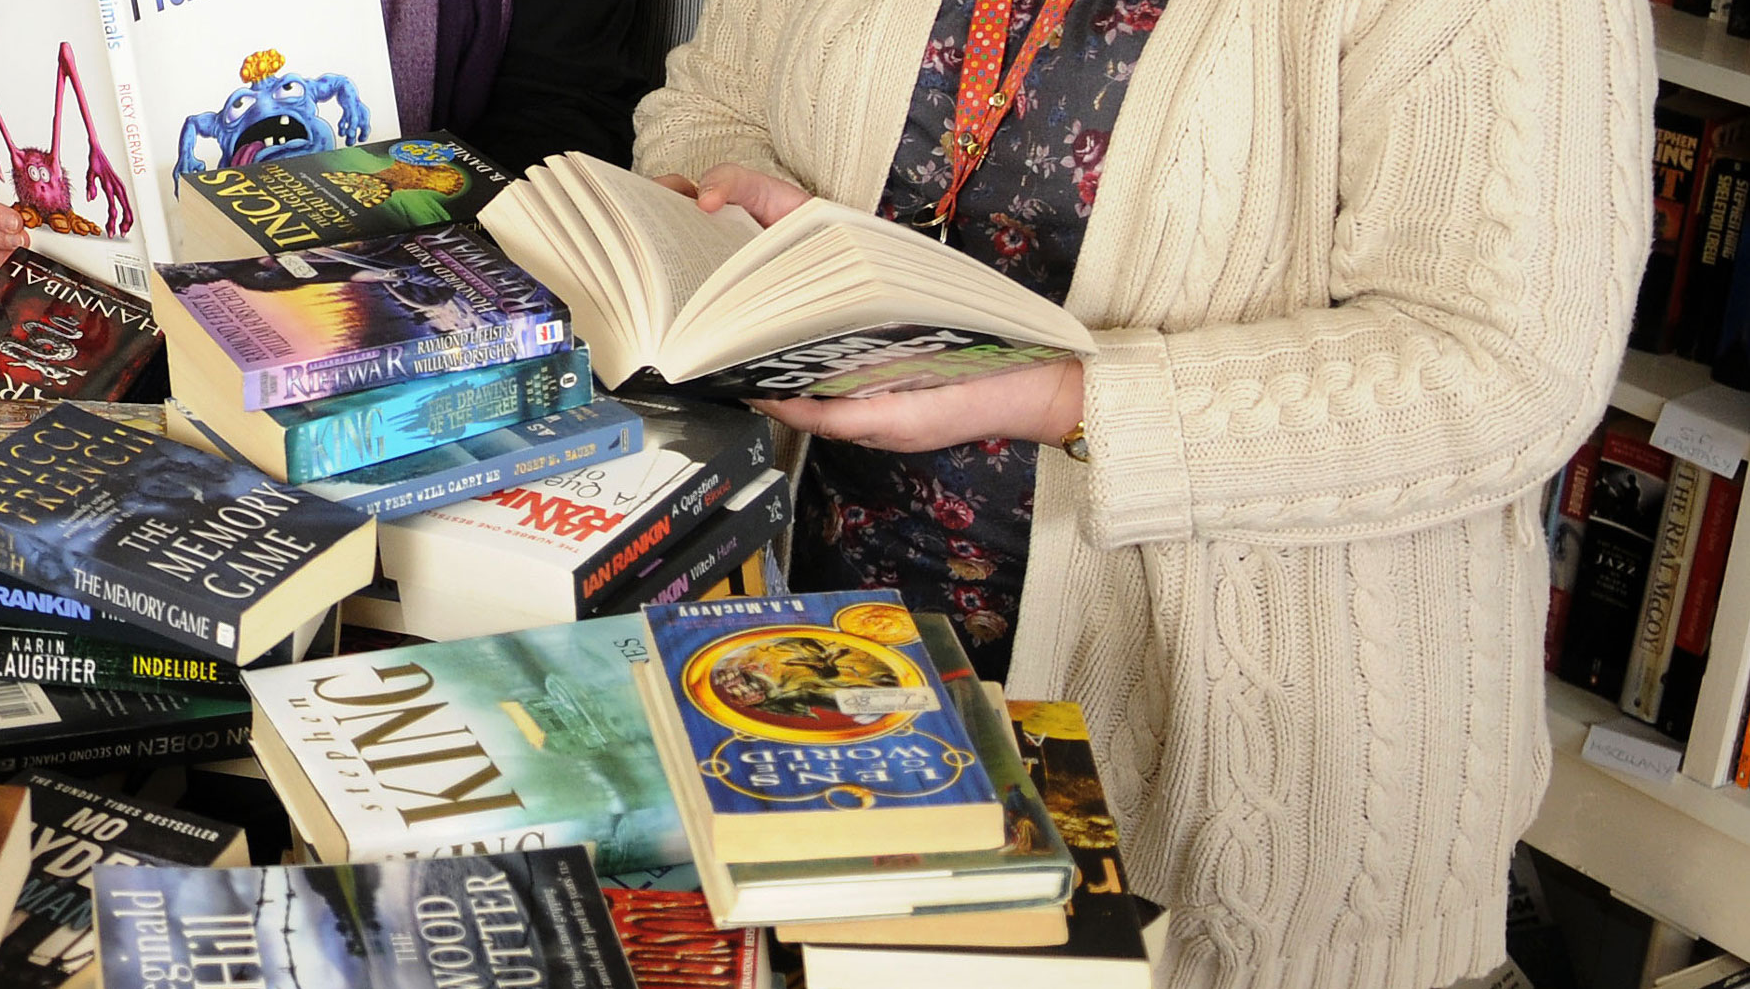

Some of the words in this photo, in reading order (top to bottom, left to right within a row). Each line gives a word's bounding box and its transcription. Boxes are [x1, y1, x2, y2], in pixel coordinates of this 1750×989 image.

[117, 83, 137, 120] RICKY
[122, 121, 148, 176] GERVAIS
[198, 169, 321, 248] INCAS
[1708, 173, 1732, 229] SKELETON
[1727, 177, 1749, 232] STEPHEN
[1702, 233, 1721, 266] CREW
[1721, 233, 1740, 261] KING
[8, 259, 164, 338] HANNIBAL
[283, 344, 410, 399] RIFTWAR
[745, 335, 894, 371] TOM
[756, 329, 973, 389] CLANCY
[308, 408, 386, 481] KING
[1673, 471, 1697, 512] THE
[117, 517, 180, 554] THE
[147, 481, 301, 583] MEMORY
[1661, 520, 1686, 575] REAL
[202, 528, 317, 602] GAME
[1594, 553, 1637, 577] JAZZ
[72, 567, 101, 597] THE
[100, 579, 166, 630] MEMORY
[167, 603, 212, 641] GAME
[1641, 580, 1672, 653] McCOY
[10, 636, 66, 656] KARIN
[131, 655, 218, 682] INDELIBLE
[21, 751, 66, 769] CHANCE
[67, 746, 113, 761] SECOND
[114, 743, 132, 757] NO
[136, 729, 220, 759] COBEN
[288, 696, 384, 811] stephen
[308, 661, 527, 830] KING
[740, 745, 931, 763] WORLD
[750, 768, 944, 786] LENS
[29, 774, 54, 787] THE
[53, 779, 101, 805] SUNDAY
[103, 797, 141, 817] TIMES
[143, 812, 220, 843] BESTSELLER
[61, 807, 130, 842] MO
